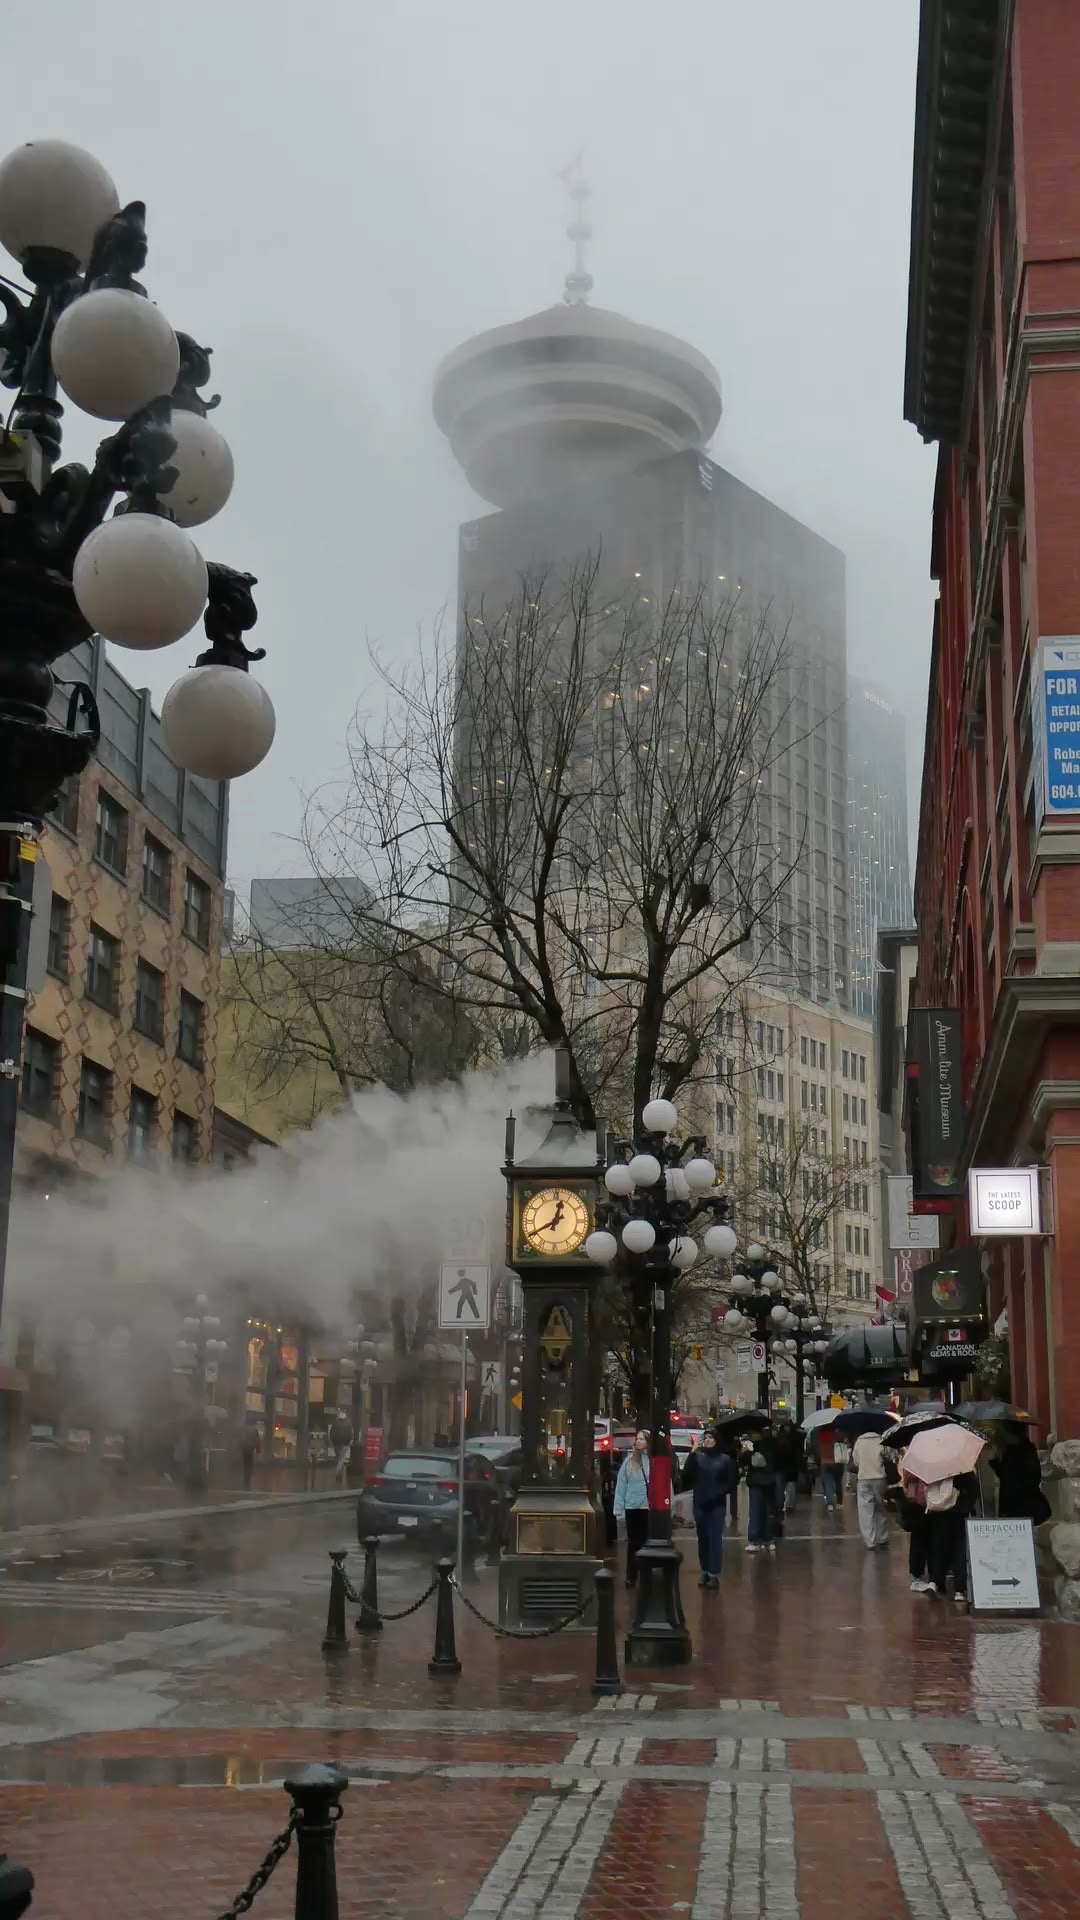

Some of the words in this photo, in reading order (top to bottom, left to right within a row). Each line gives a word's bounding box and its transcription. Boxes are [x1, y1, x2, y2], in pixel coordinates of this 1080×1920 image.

[1047, 677, 1077, 695] FOR
[936, 1020, 952, 1080] Ammlite
[939, 1082, 951, 1140] Museum
[989, 1191, 998, 1199] THE
[1001, 1191, 1020, 1199] LATEST
[988, 1200, 1021, 1211] SCOOP
[936, 1343, 975, 1351] CANADIAN
[930, 1350, 951, 1358] GEMS
[973, 1523, 1026, 1533] BERTACCHI
